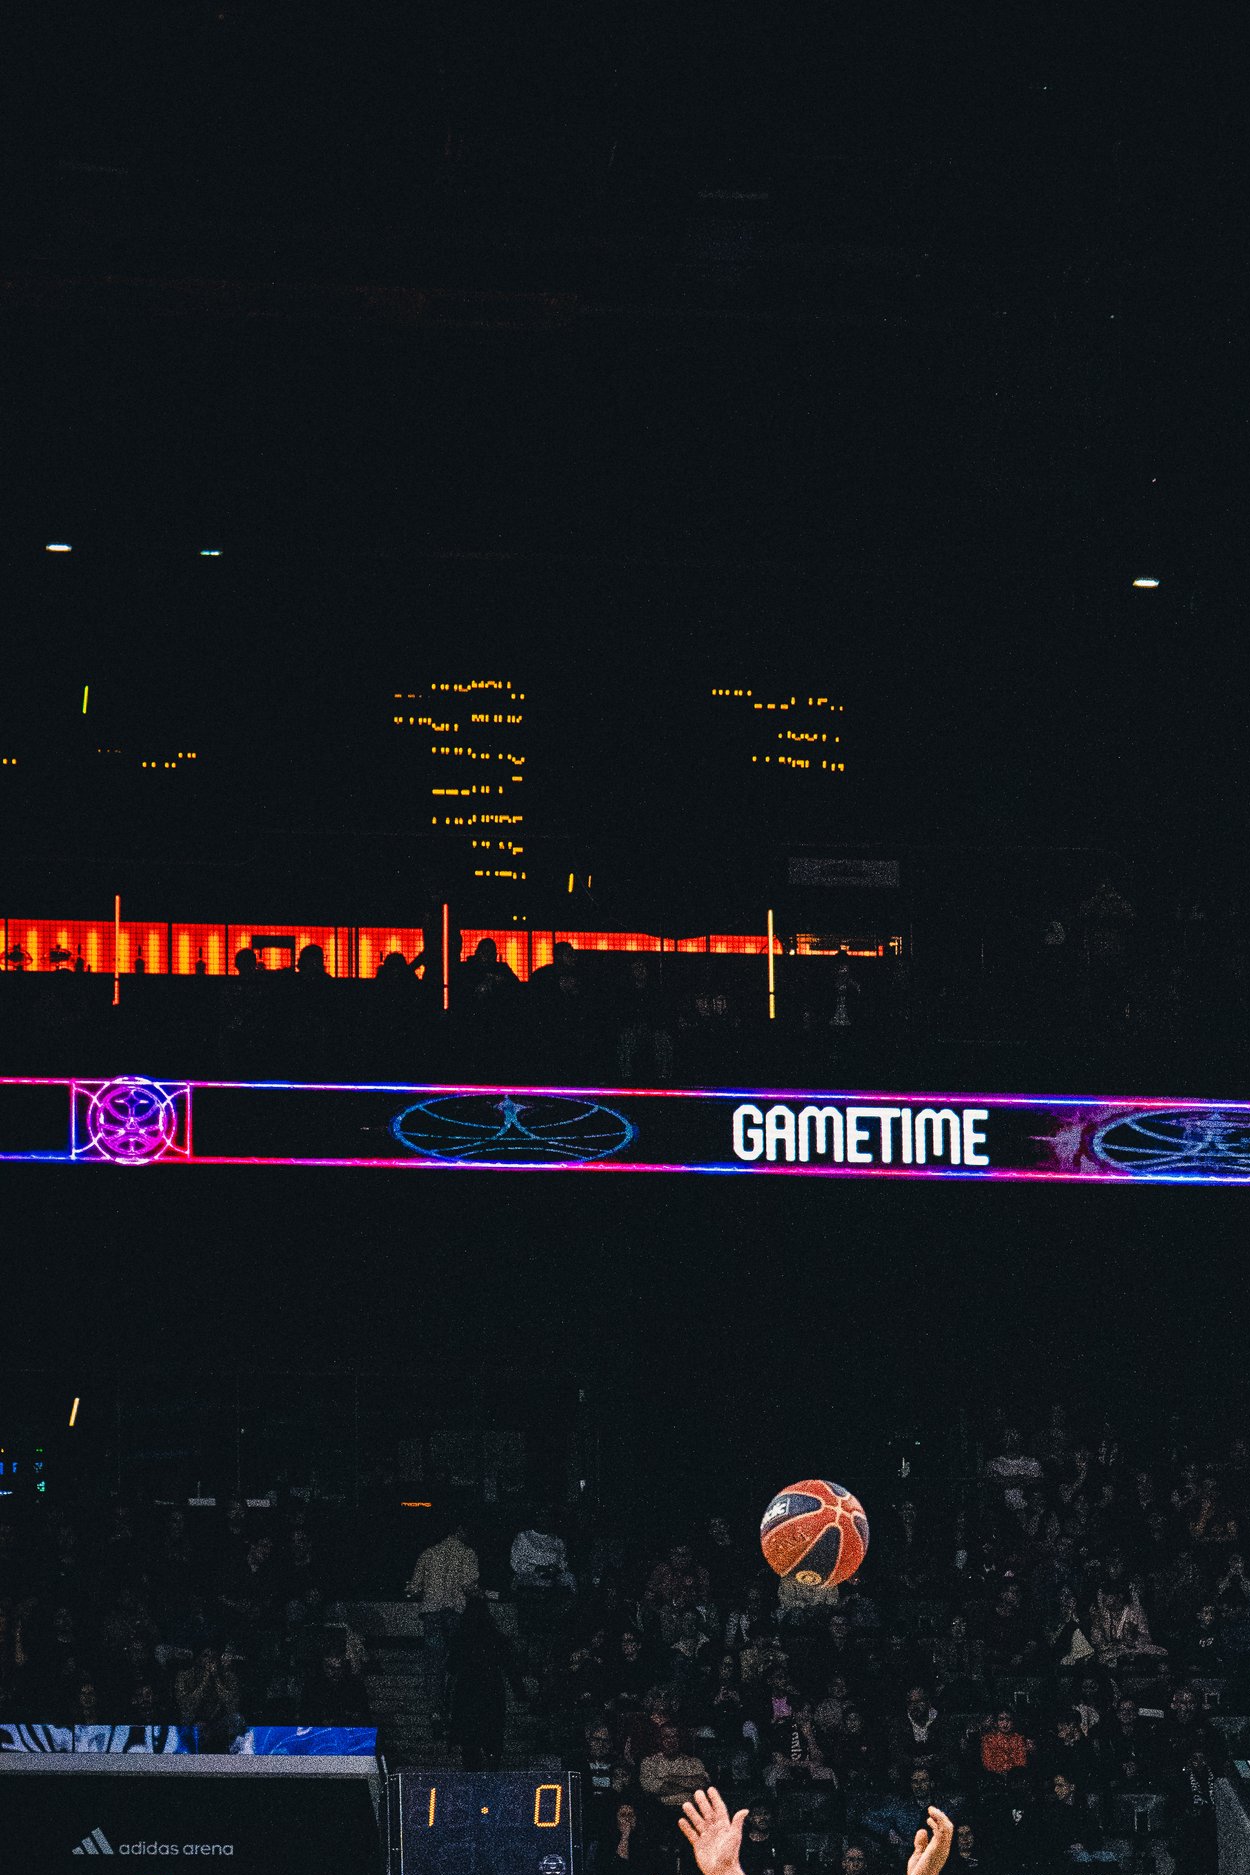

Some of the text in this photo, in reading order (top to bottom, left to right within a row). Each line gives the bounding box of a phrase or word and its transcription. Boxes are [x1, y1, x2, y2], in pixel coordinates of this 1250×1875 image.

[733, 1104, 989, 1165] GAMETIME
[429, 1784, 562, 1828] 1 0
[119, 1842, 234, 1855] adidas arena
